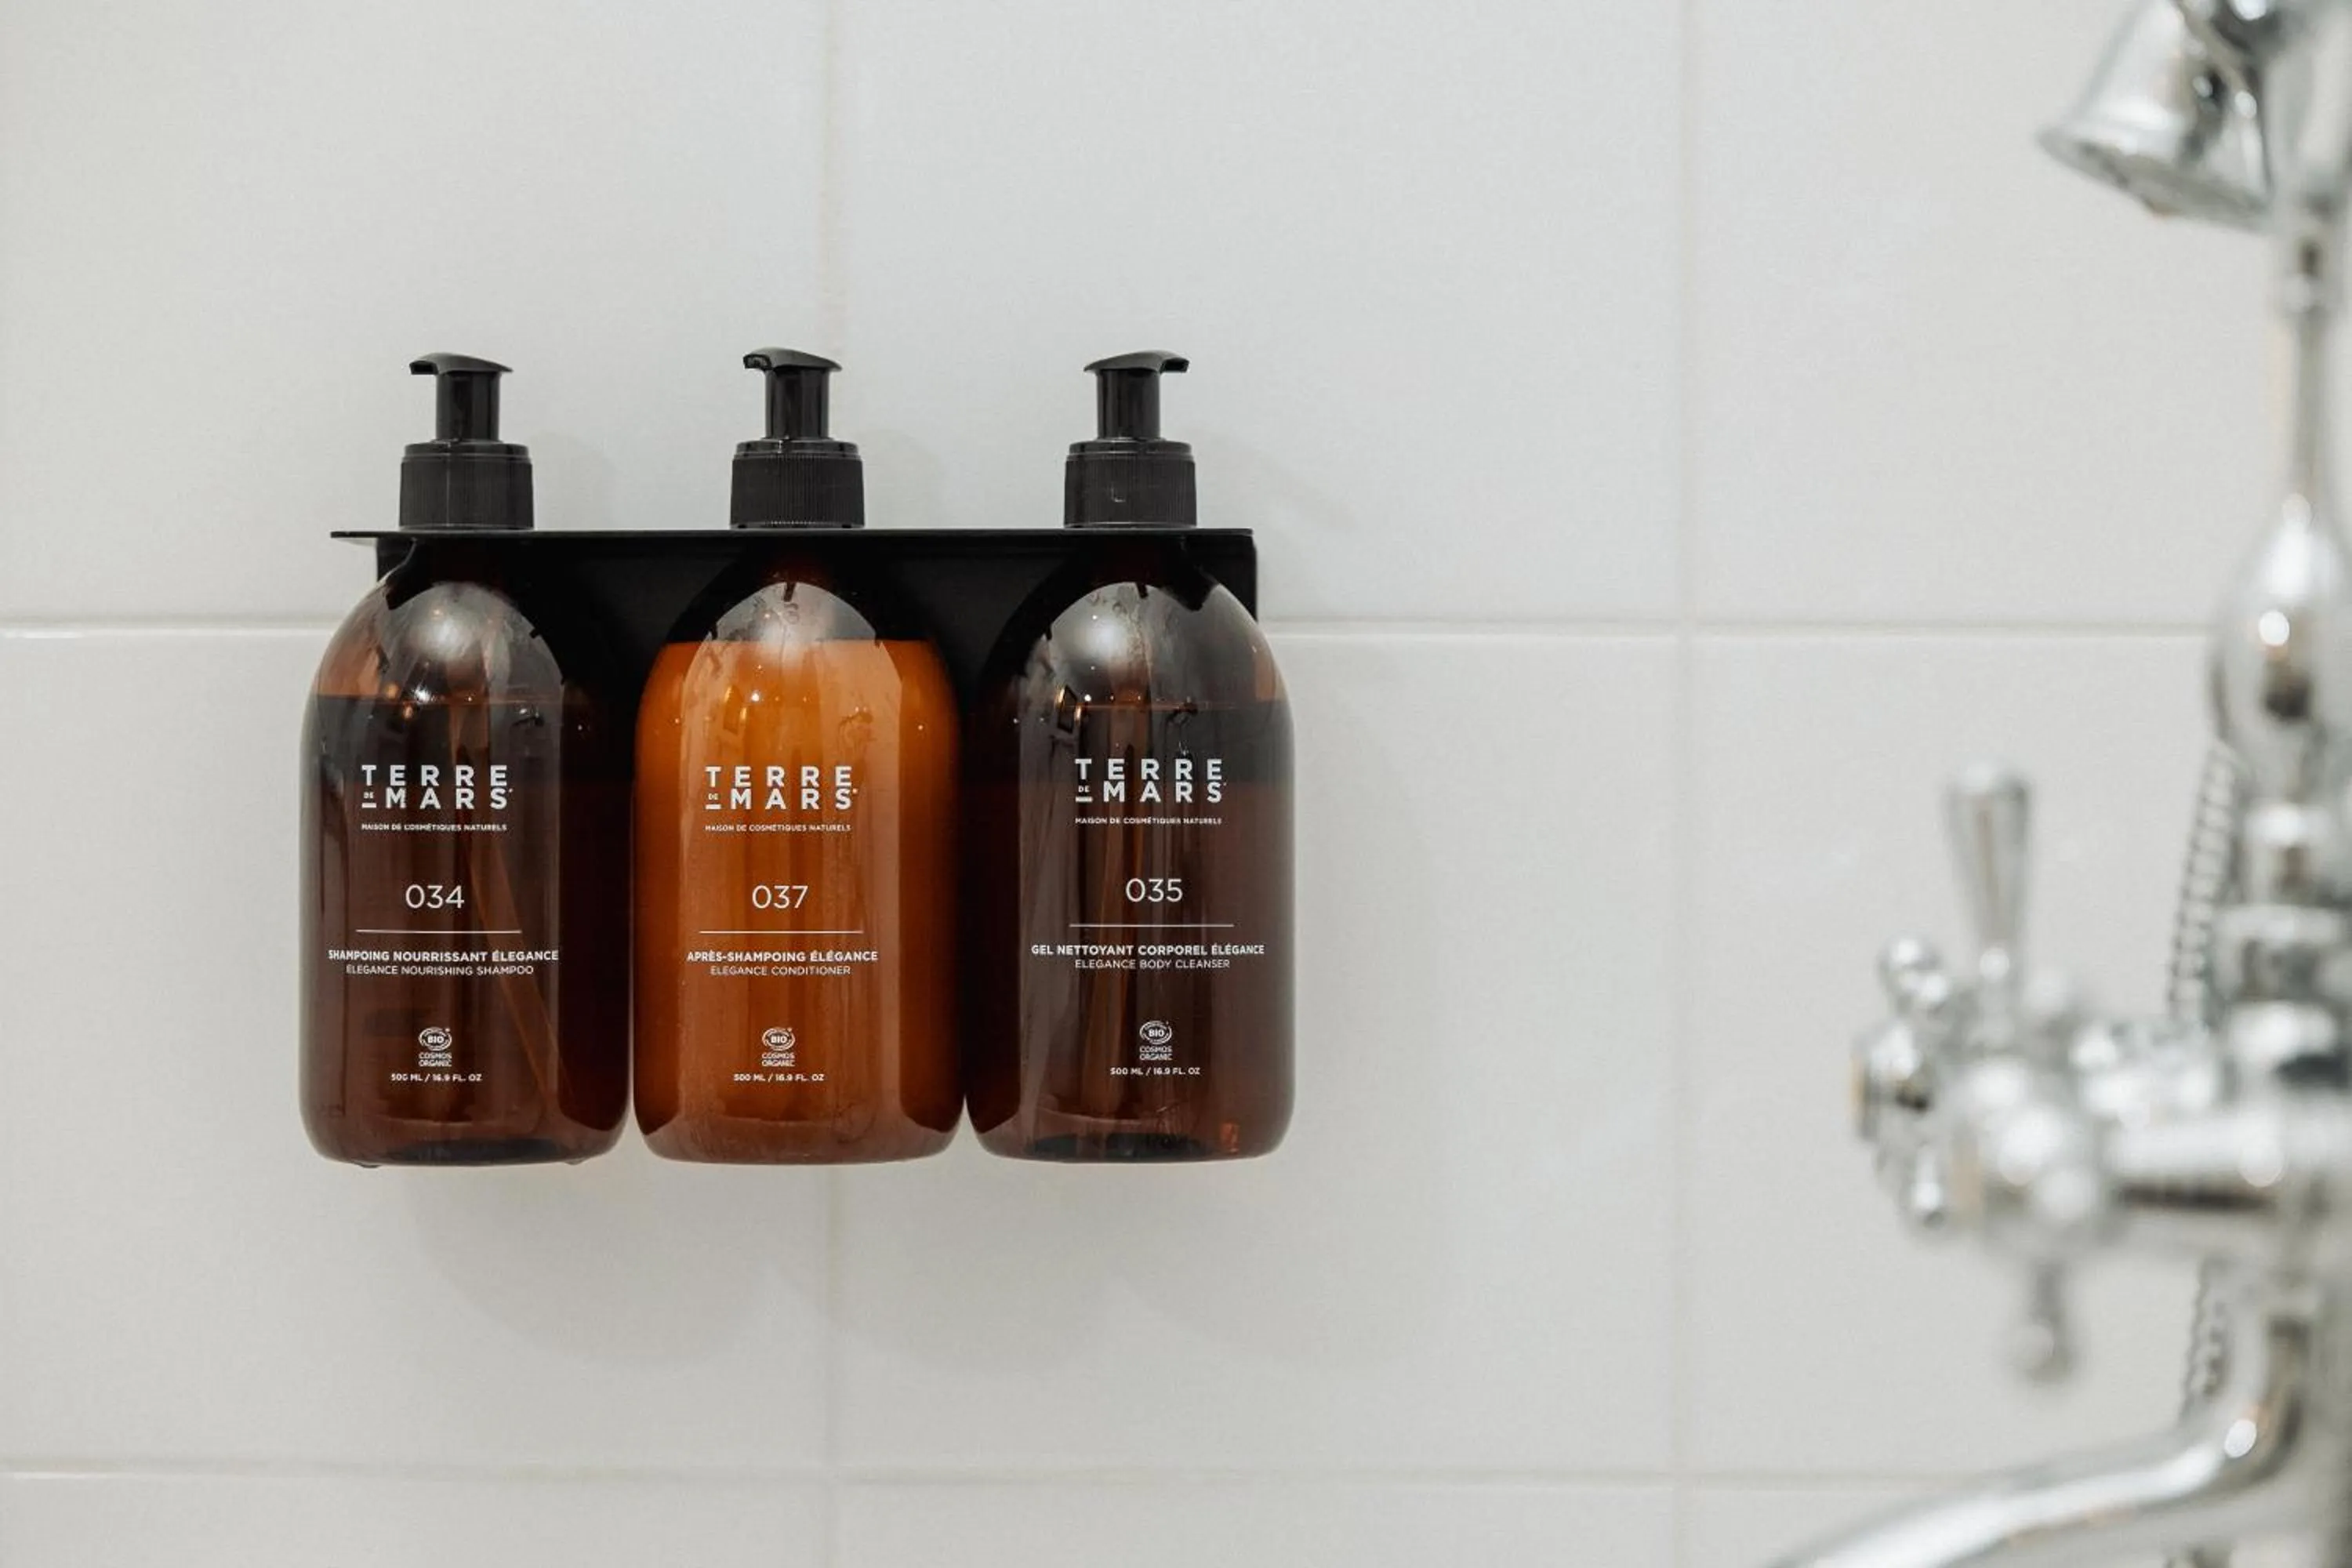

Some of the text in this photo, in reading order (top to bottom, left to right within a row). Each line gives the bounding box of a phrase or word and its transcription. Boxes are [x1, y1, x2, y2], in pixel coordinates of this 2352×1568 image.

[361, 764, 508, 786] TERRE
[706, 766, 851, 787] TERRE
[1075, 758, 1222, 780] TERRE
[386, 787, 508, 809] MARS
[730, 788, 851, 810] MARS
[1103, 781, 1222, 803] MARS
[405, 884, 465, 909] 034
[752, 885, 808, 909] 037
[1126, 878, 1183, 902] 035
[328, 949, 390, 961] SHAMPOING
[393, 951, 488, 962] NOURRISSANT
[687, 949, 878, 962] APRÈS-SHAMPOING ÉLÉGANCE
[1031, 942, 1265, 956] GEL NETTOYANT CORPOREL ÉLÉGANCE
[401, 965, 473, 975] NOURISHING
[476, 965, 534, 975] SHAMPOO
[771, 965, 851, 975] CONDITIONER
[1075, 959, 1230, 969] ELEGANCE BODY CLEANSER
[1149, 1029, 1164, 1037] BIO
